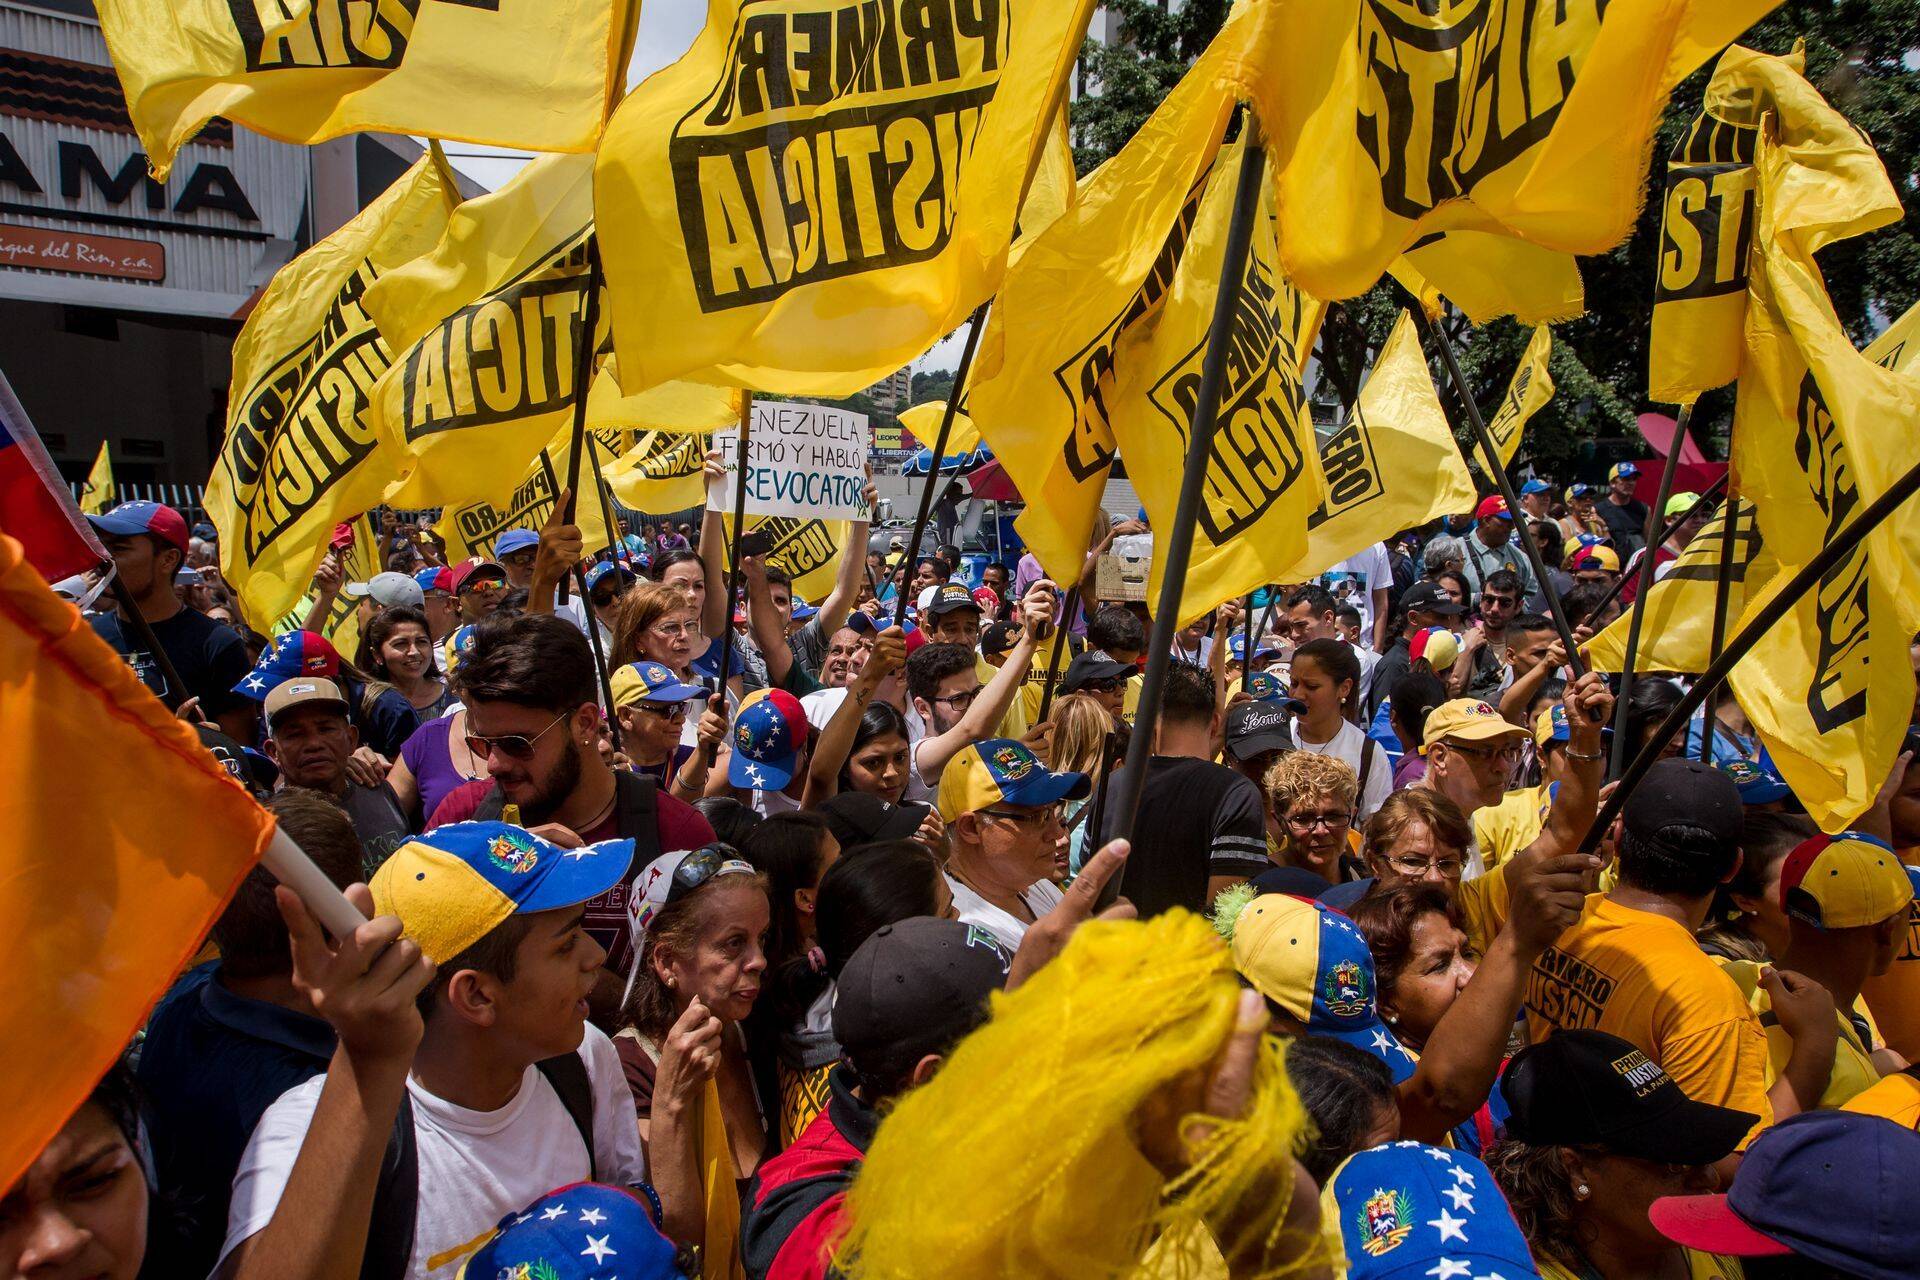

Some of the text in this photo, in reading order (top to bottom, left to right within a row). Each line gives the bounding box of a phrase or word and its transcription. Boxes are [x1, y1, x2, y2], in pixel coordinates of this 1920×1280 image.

[41, 241, 70, 258] del
[790, 443, 804, 464] Y
[812, 446, 861, 470] HABLÓ
